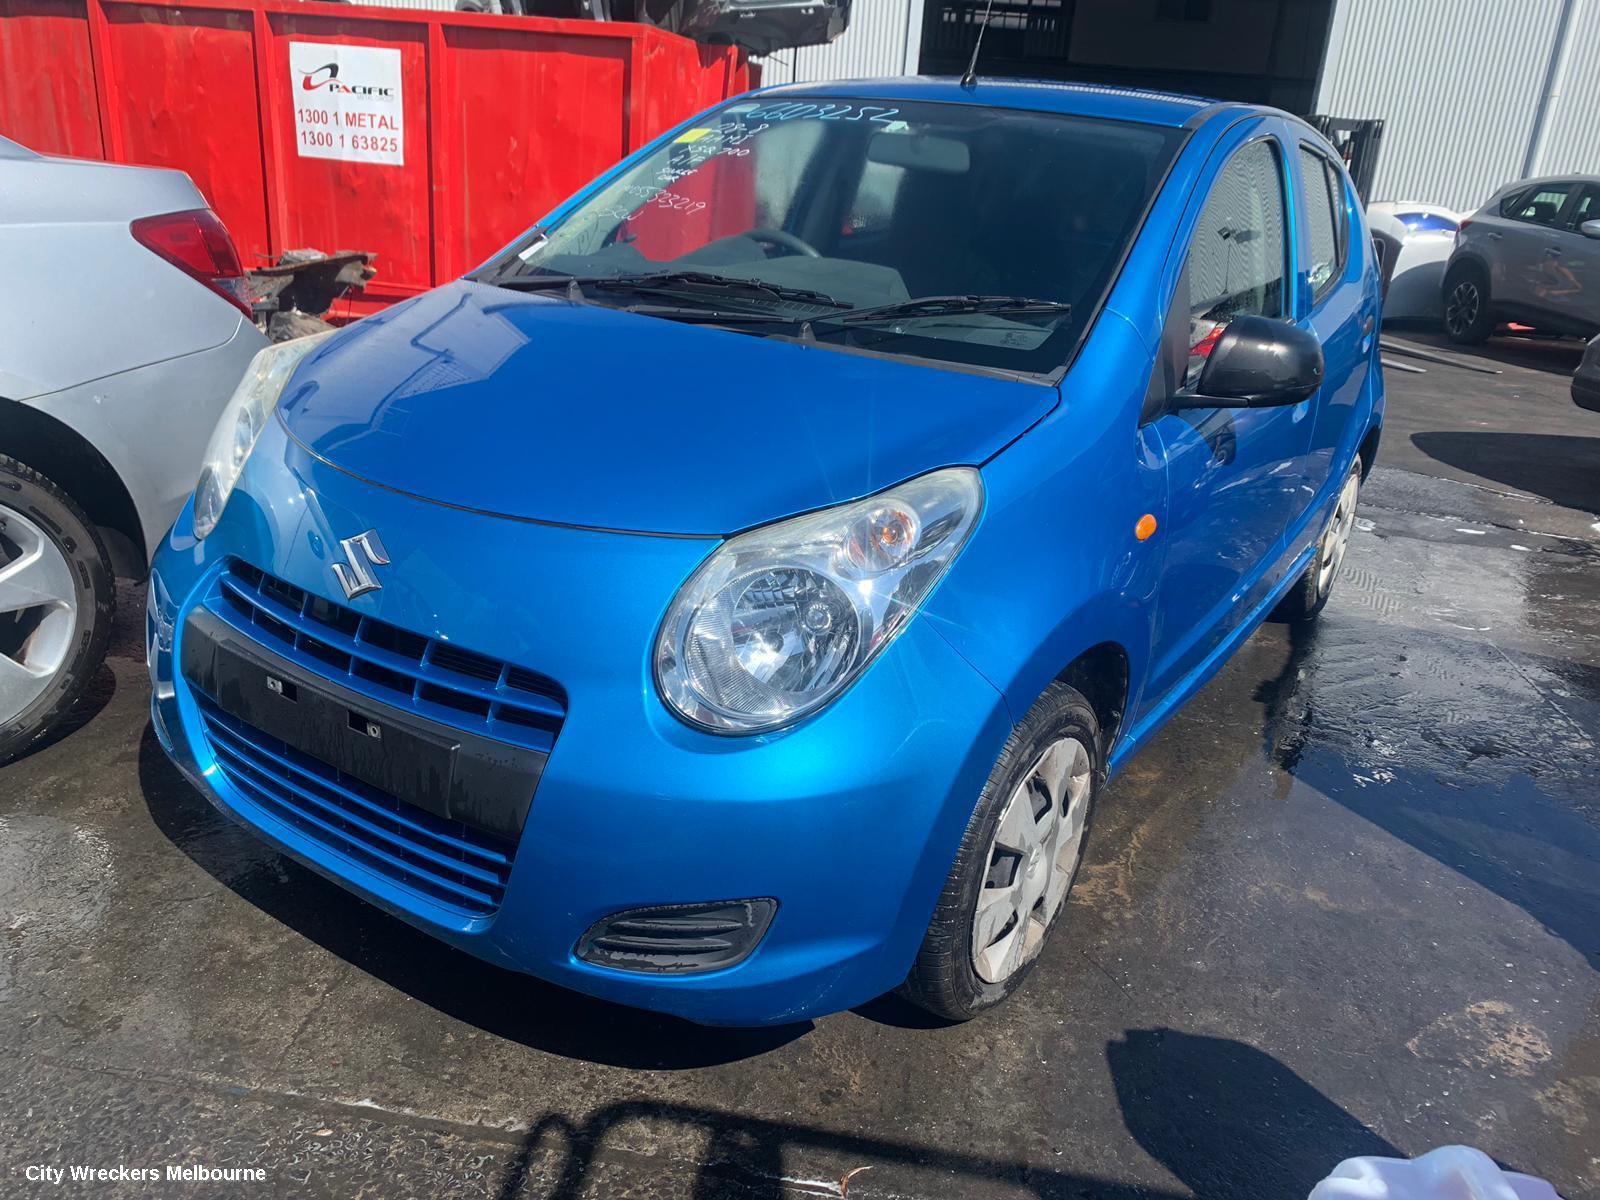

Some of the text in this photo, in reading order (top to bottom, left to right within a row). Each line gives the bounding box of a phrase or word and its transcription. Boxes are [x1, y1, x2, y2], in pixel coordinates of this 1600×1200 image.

[329, 83, 395, 97] PACIFIC
[298, 108, 399, 130] 1300 1 METAL
[301, 130, 398, 153] 1300 1 63825
